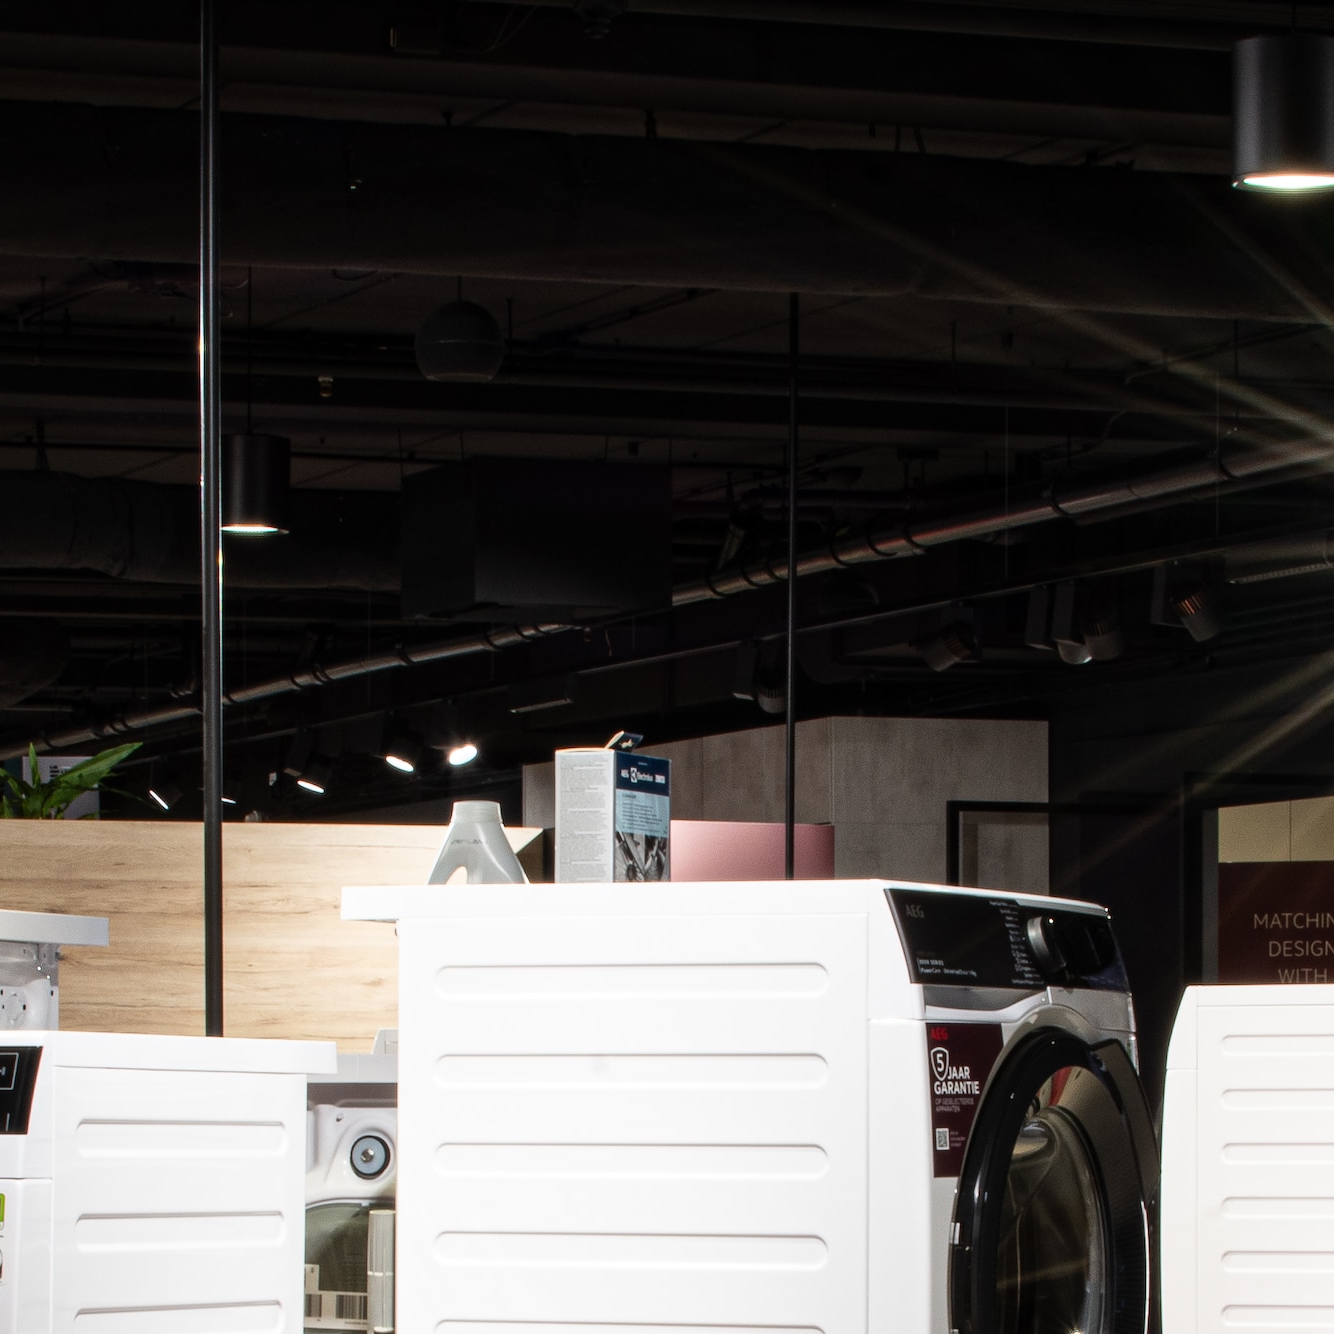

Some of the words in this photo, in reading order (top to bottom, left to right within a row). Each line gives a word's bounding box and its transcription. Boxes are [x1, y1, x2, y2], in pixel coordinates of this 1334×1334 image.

[905, 904, 924, 919] AEG
[1278, 968, 1328, 984] WITH
[930, 1027, 949, 1041] AEG
[936, 1053, 945, 1072] 5
[947, 1066, 971, 1080] JAAR
[934, 1081, 980, 1095] GARANTIE
